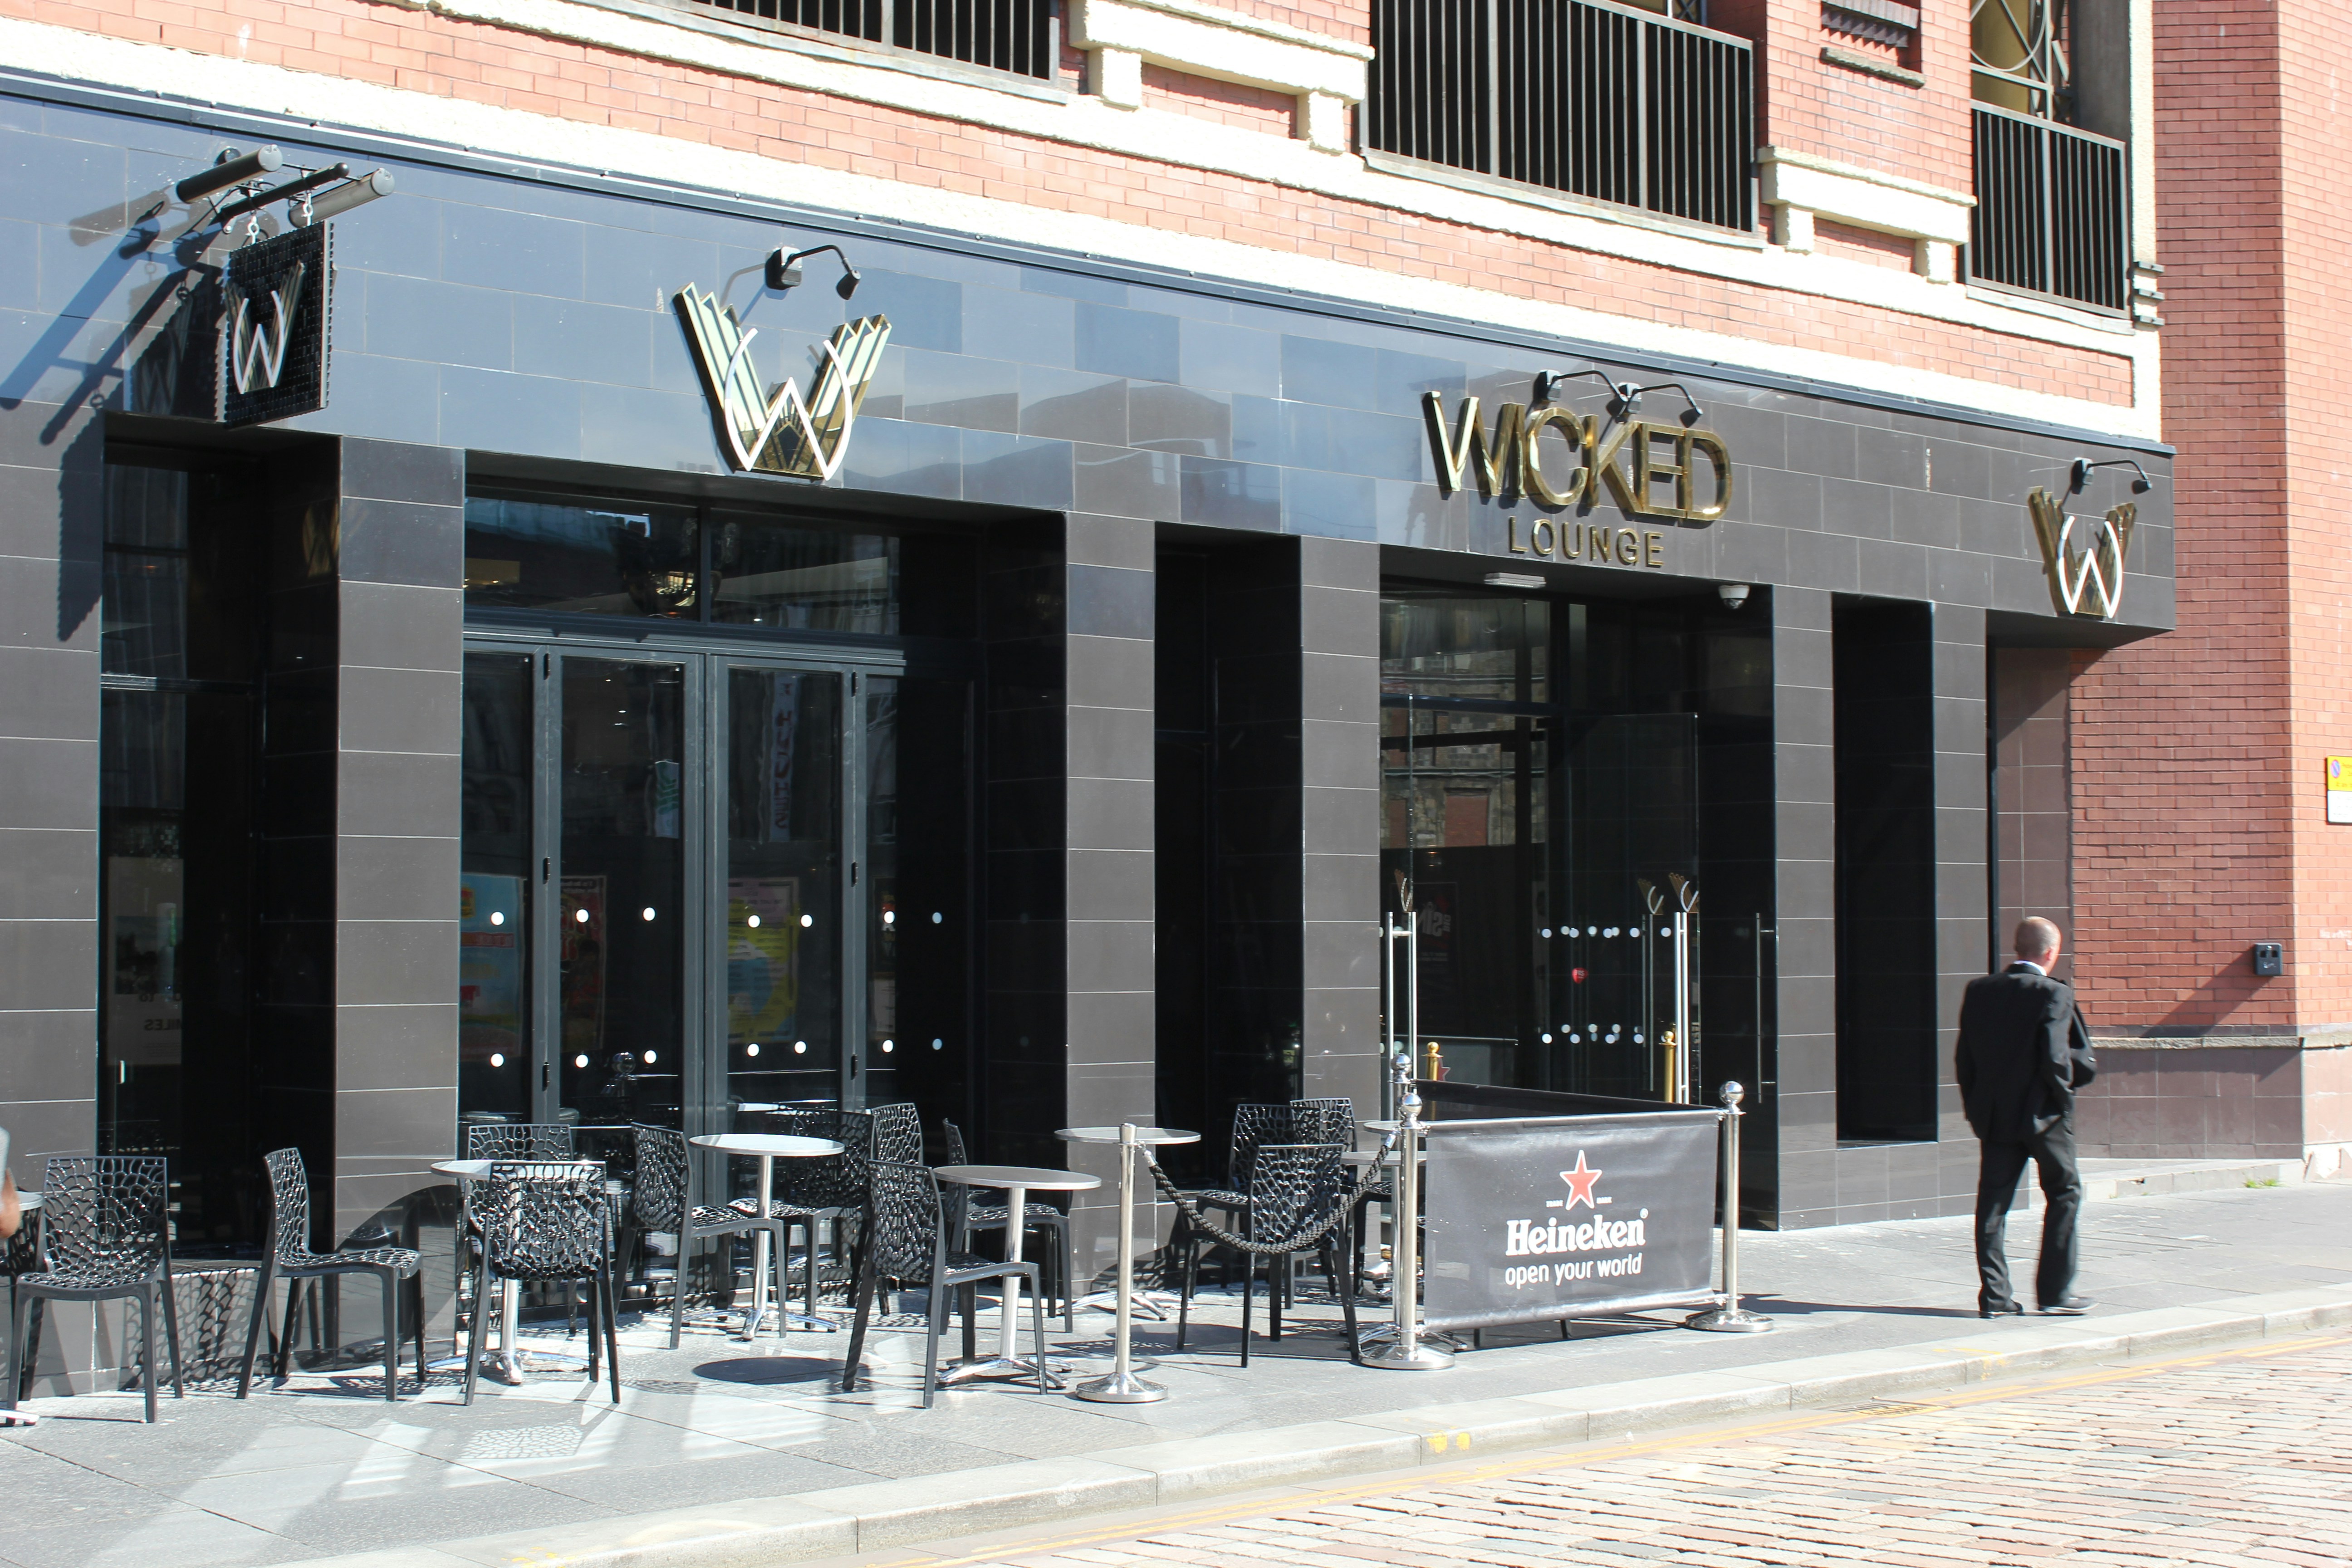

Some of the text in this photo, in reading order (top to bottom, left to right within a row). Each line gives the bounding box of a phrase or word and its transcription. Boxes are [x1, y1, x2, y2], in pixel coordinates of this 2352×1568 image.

[1421, 391, 1733, 521] WICKED
[1509, 516, 1664, 566] LOUNGE
[1505, 1252, 1642, 1289] open your world
